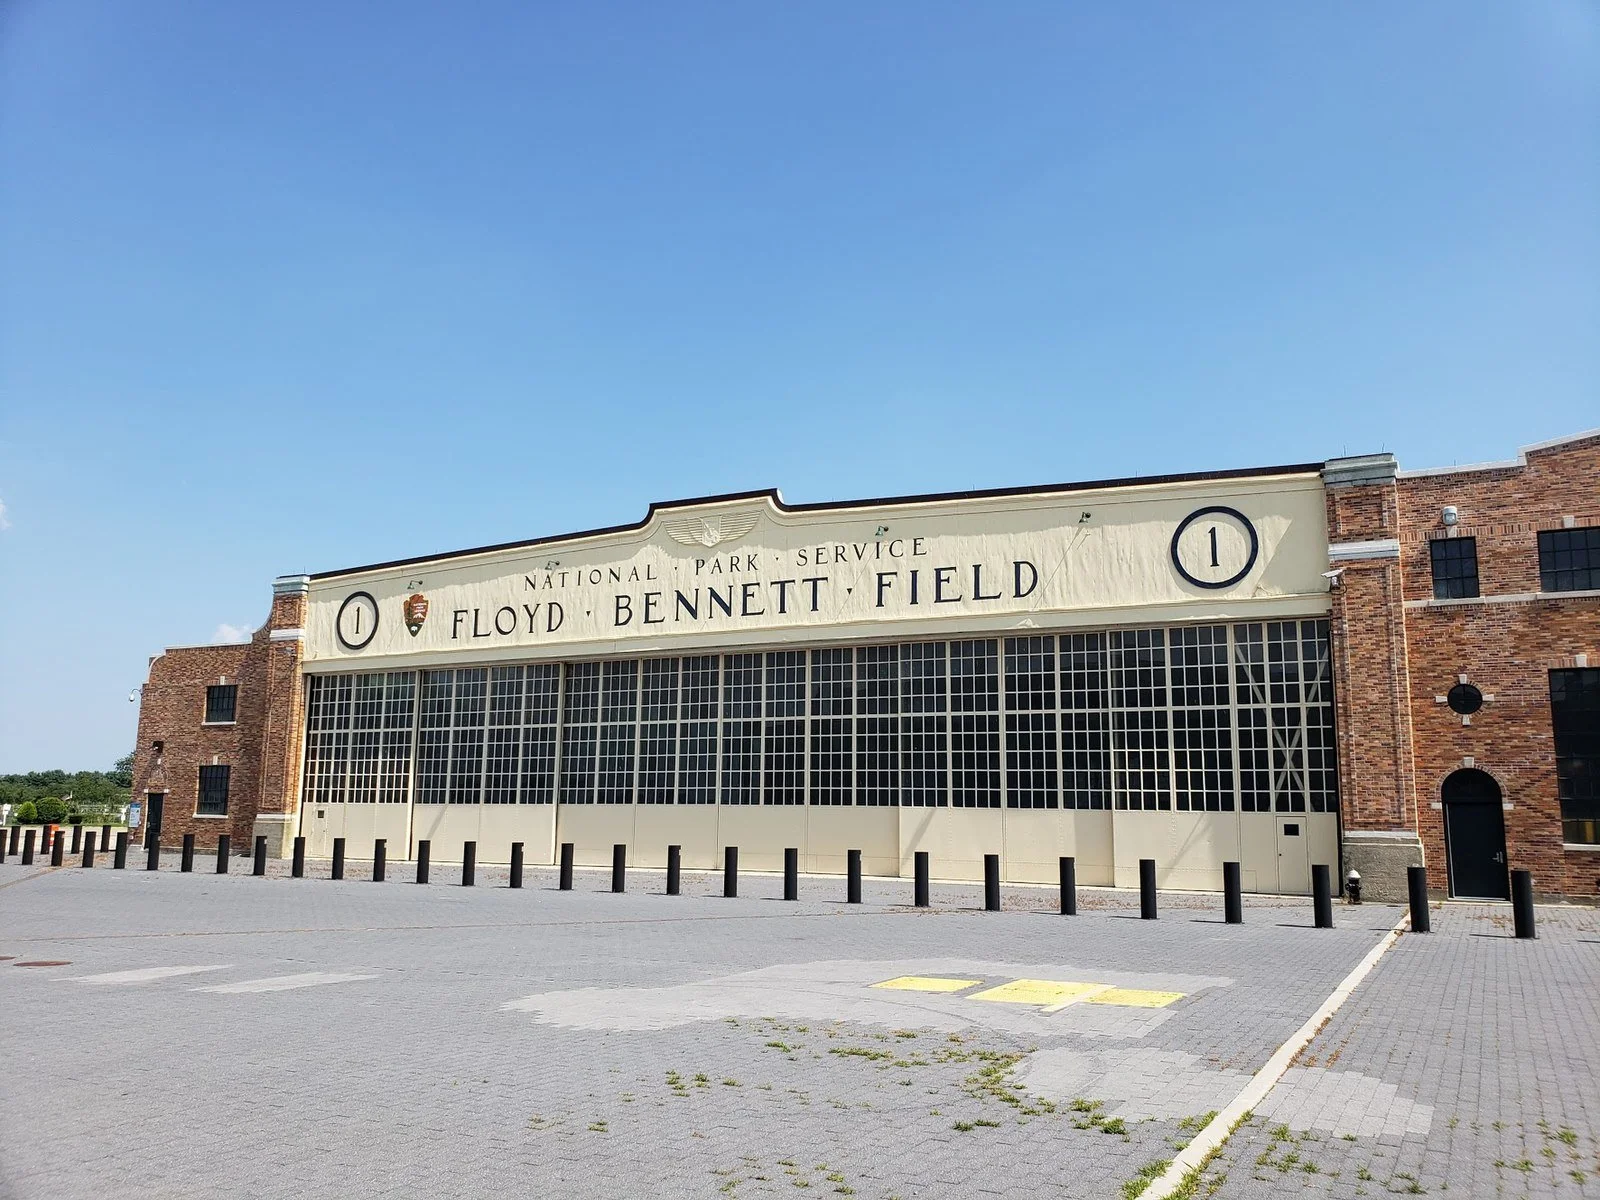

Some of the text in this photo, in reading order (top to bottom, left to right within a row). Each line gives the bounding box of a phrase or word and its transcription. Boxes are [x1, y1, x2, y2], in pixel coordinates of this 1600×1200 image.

[524, 536, 928, 592] NATIONAL PARK SERVICE
[1207, 526, 1220, 568] 1
[354, 606, 362, 635] 1
[451, 560, 1039, 640] FLOYD BENNETT FIELD
